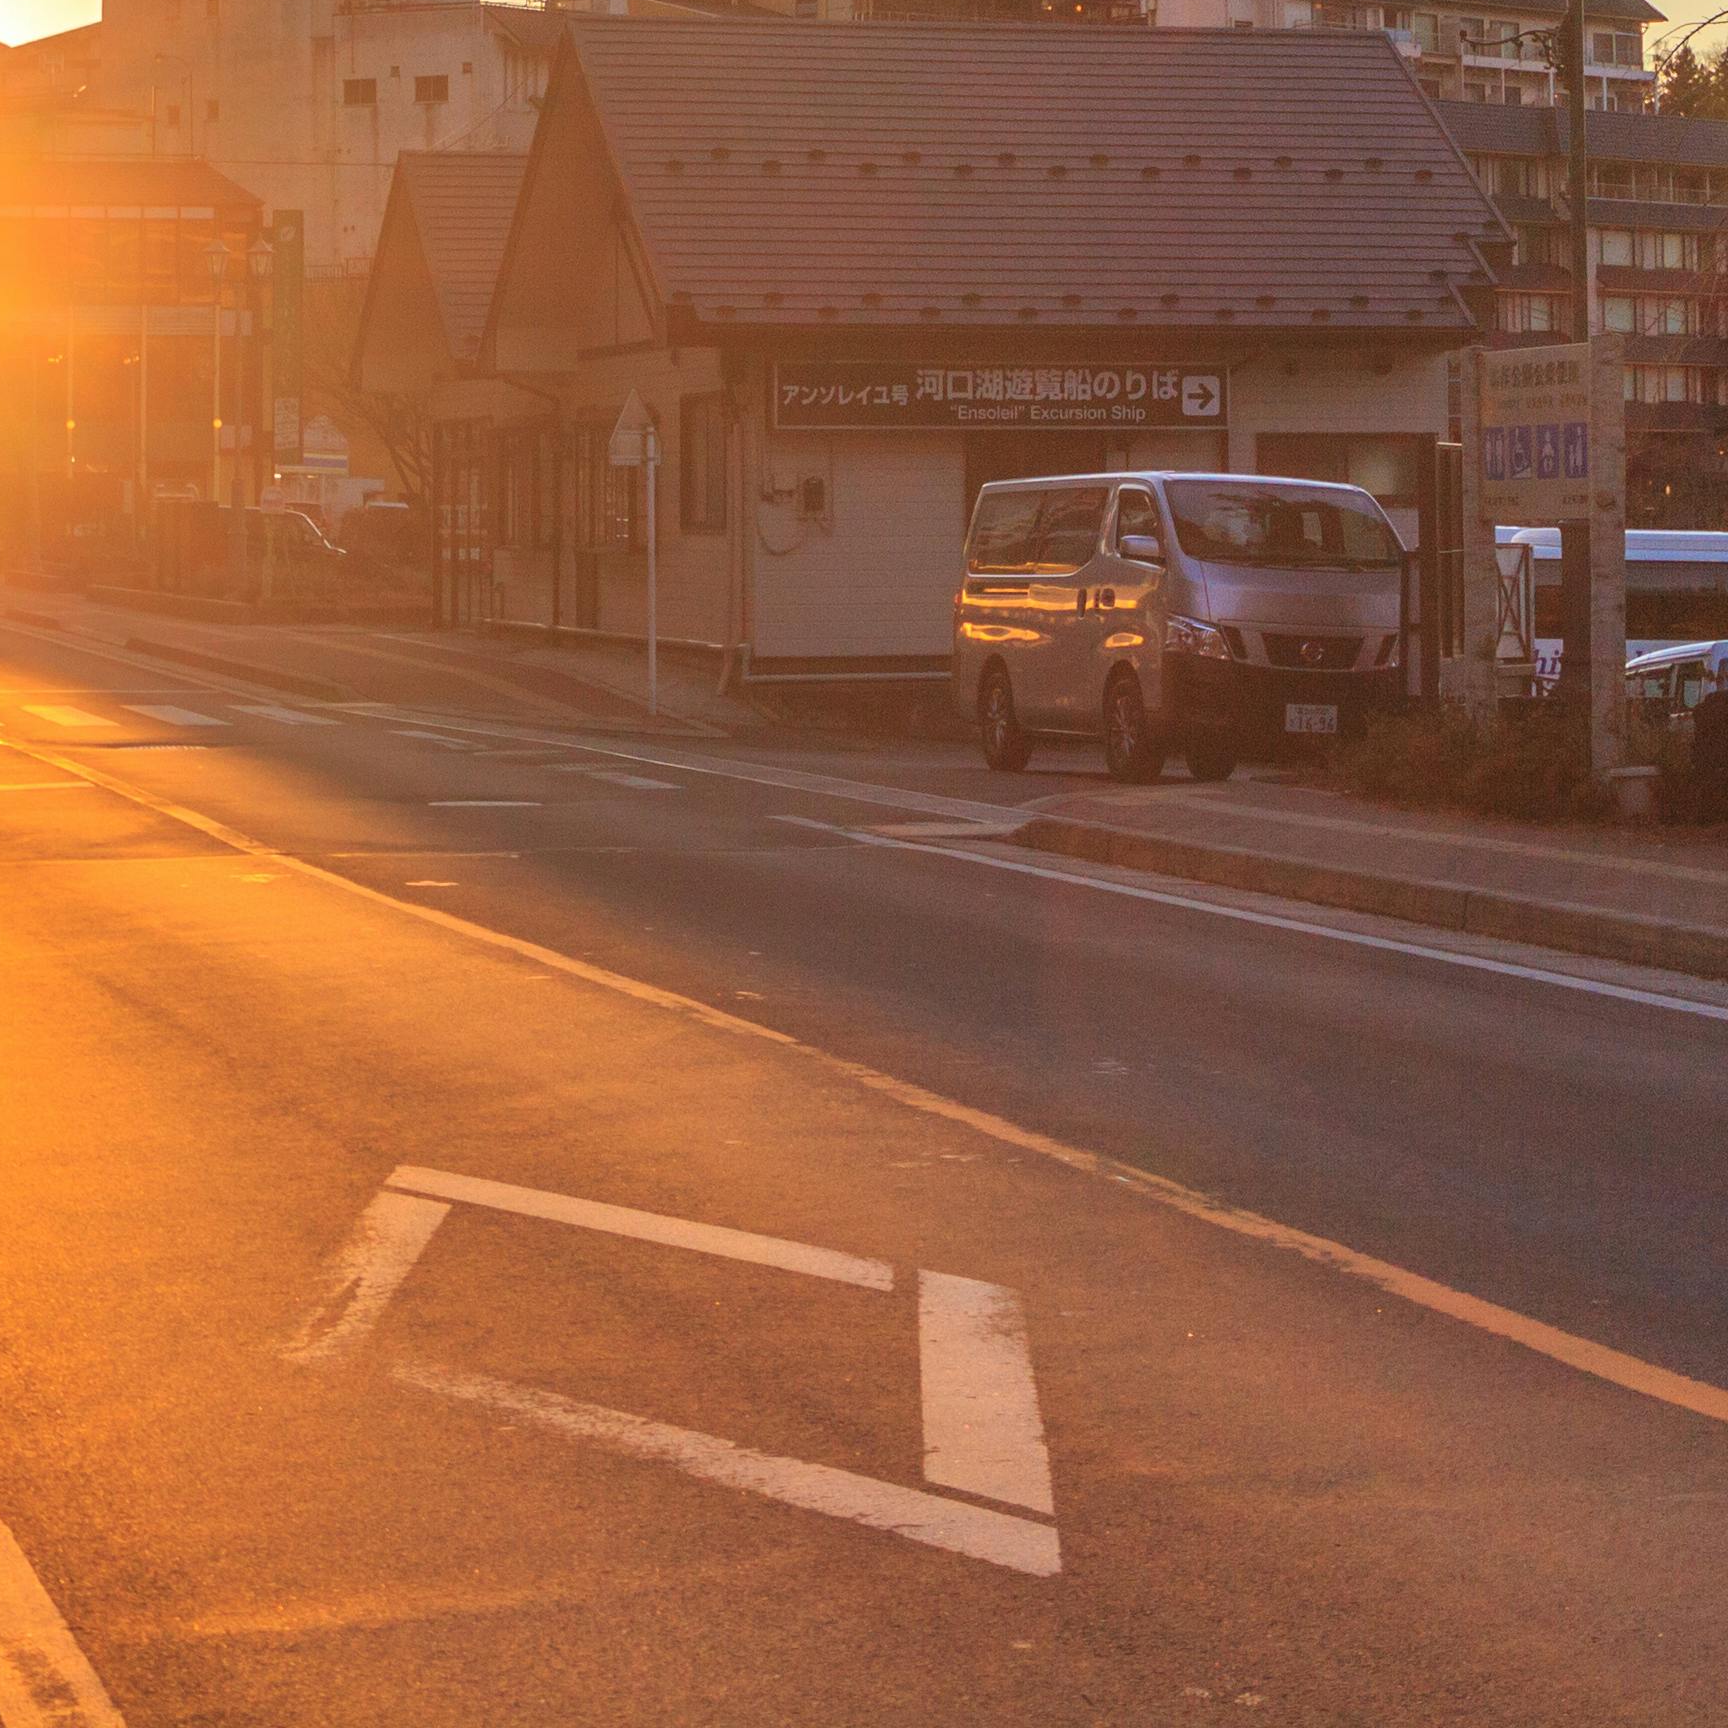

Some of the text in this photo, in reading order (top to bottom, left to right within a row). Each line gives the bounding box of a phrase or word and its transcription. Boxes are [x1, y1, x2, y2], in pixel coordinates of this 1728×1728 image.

[782, 368, 1180, 407] アンソレイユ号 河口湖遊覧船のりば
[1029, 404, 1107, 421] Excursion
[1111, 404, 1147, 424] Ship
